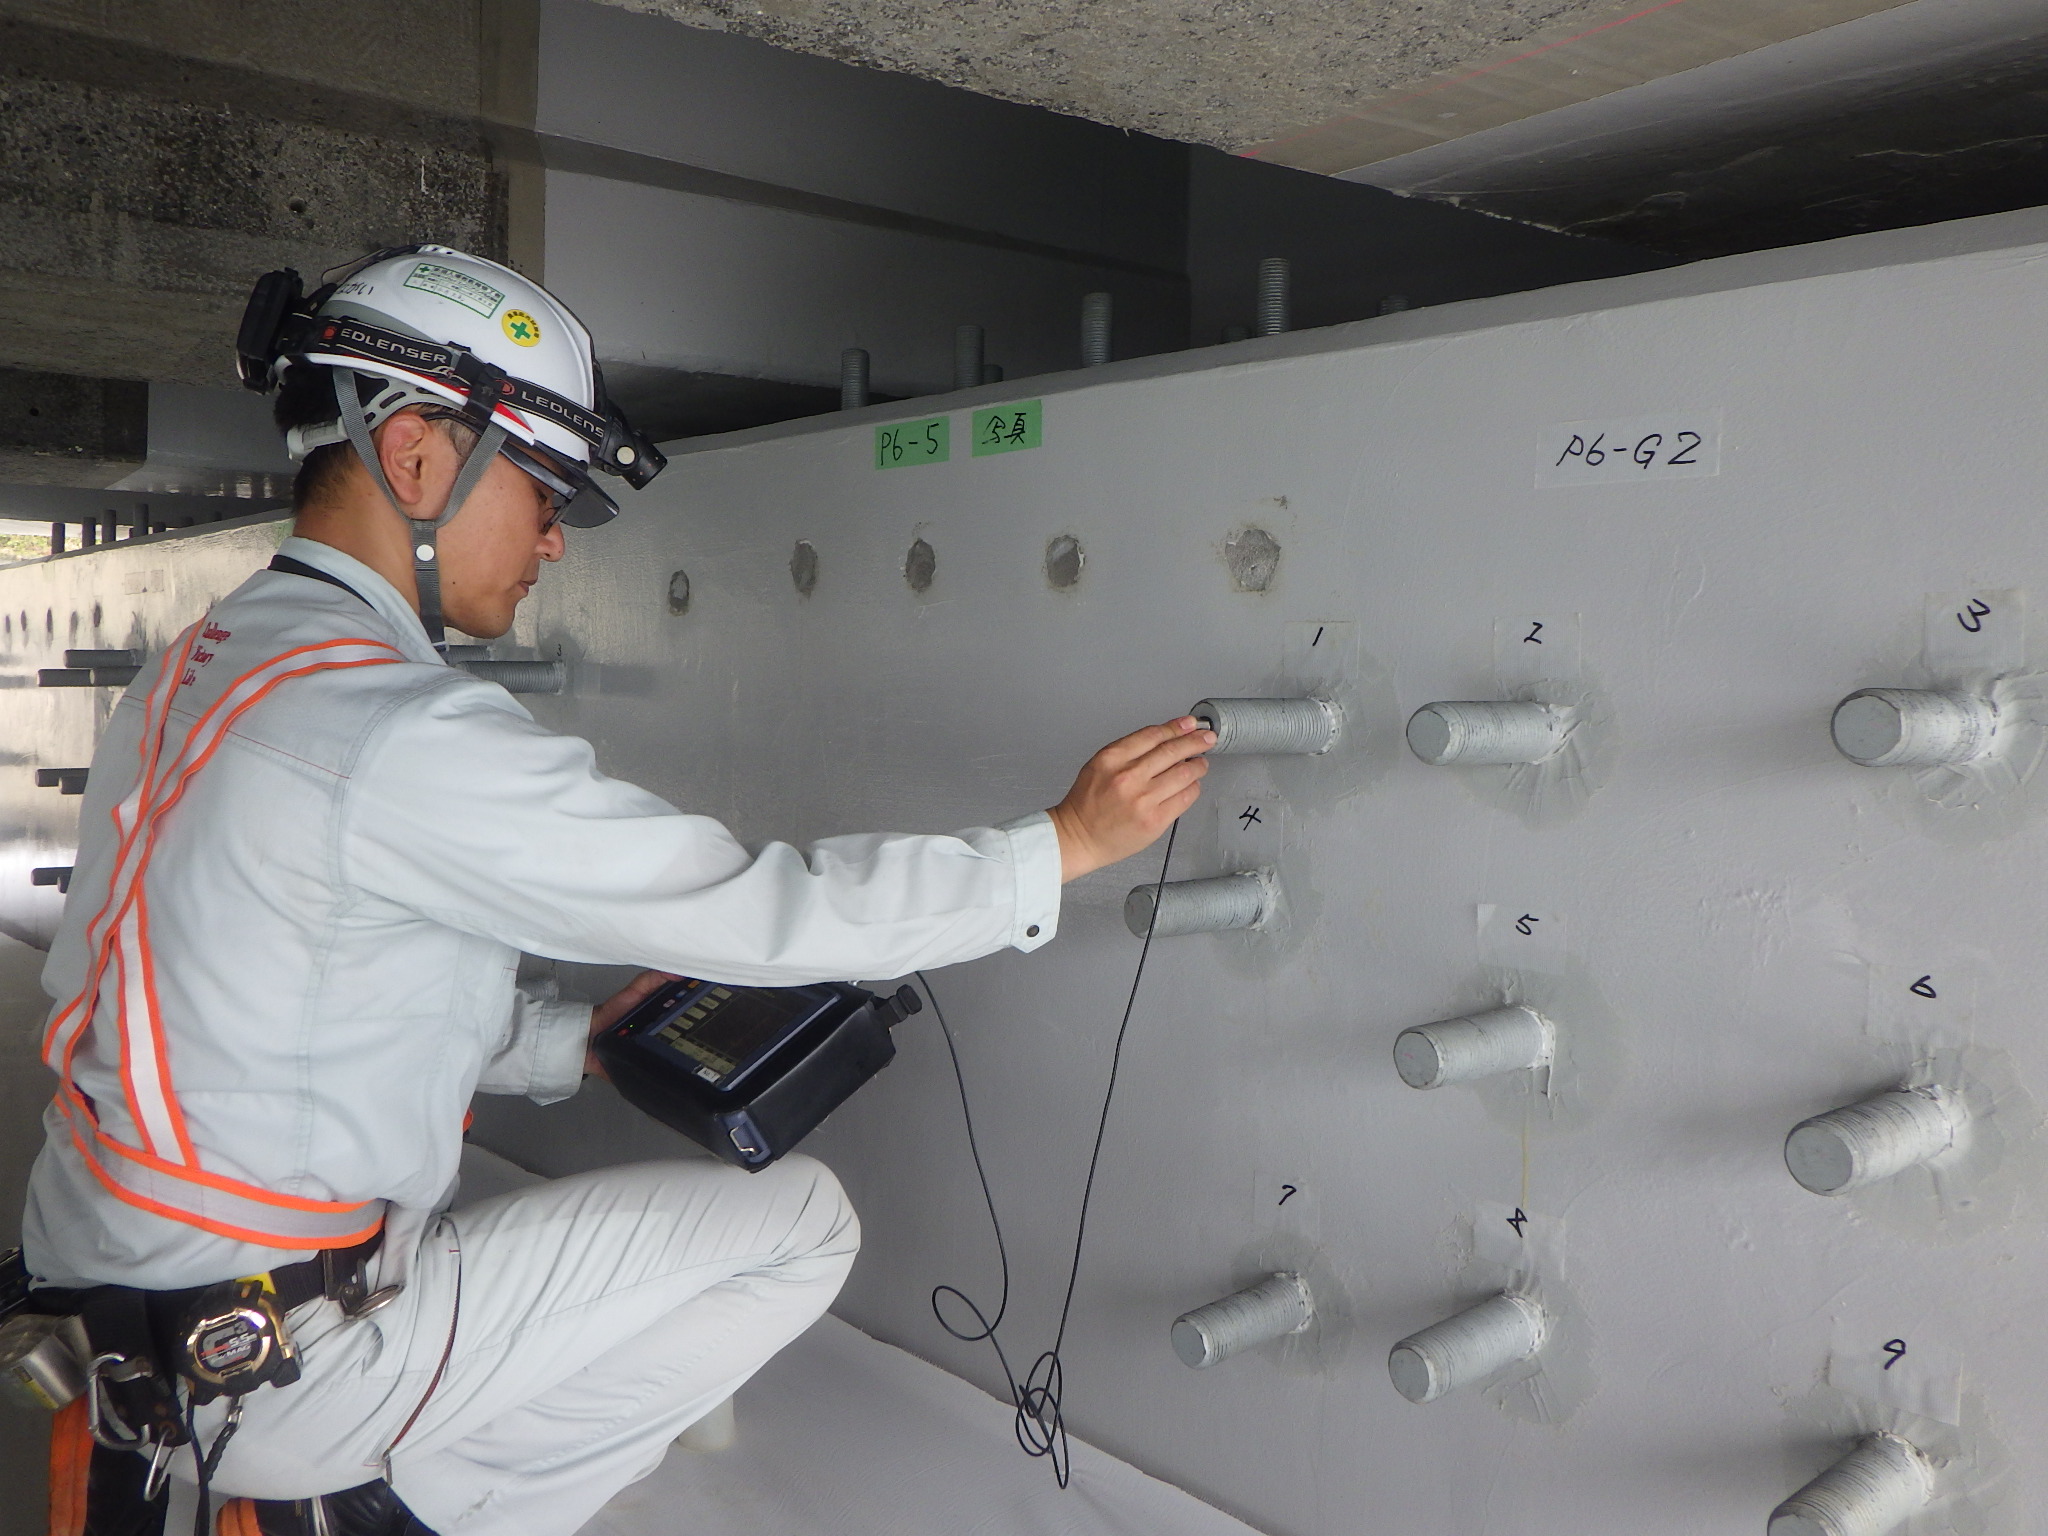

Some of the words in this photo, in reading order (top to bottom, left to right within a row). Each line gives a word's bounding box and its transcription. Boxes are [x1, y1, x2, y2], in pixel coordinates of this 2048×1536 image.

[340, 328, 448, 364] EDLENSER
[521, 391, 605, 438] LEDLENS
[880, 423, 940, 466] P6-5
[1957, 598, 1991, 633] 3
[1312, 626, 1324, 647] 1
[1523, 621, 1543, 645] 2
[1238, 805, 1262, 831] 4
[1515, 913, 1540, 936] 5
[1909, 974, 1937, 999] 6
[1278, 1184, 1297, 1206] 7
[1882, 1338, 1907, 1371] 9
